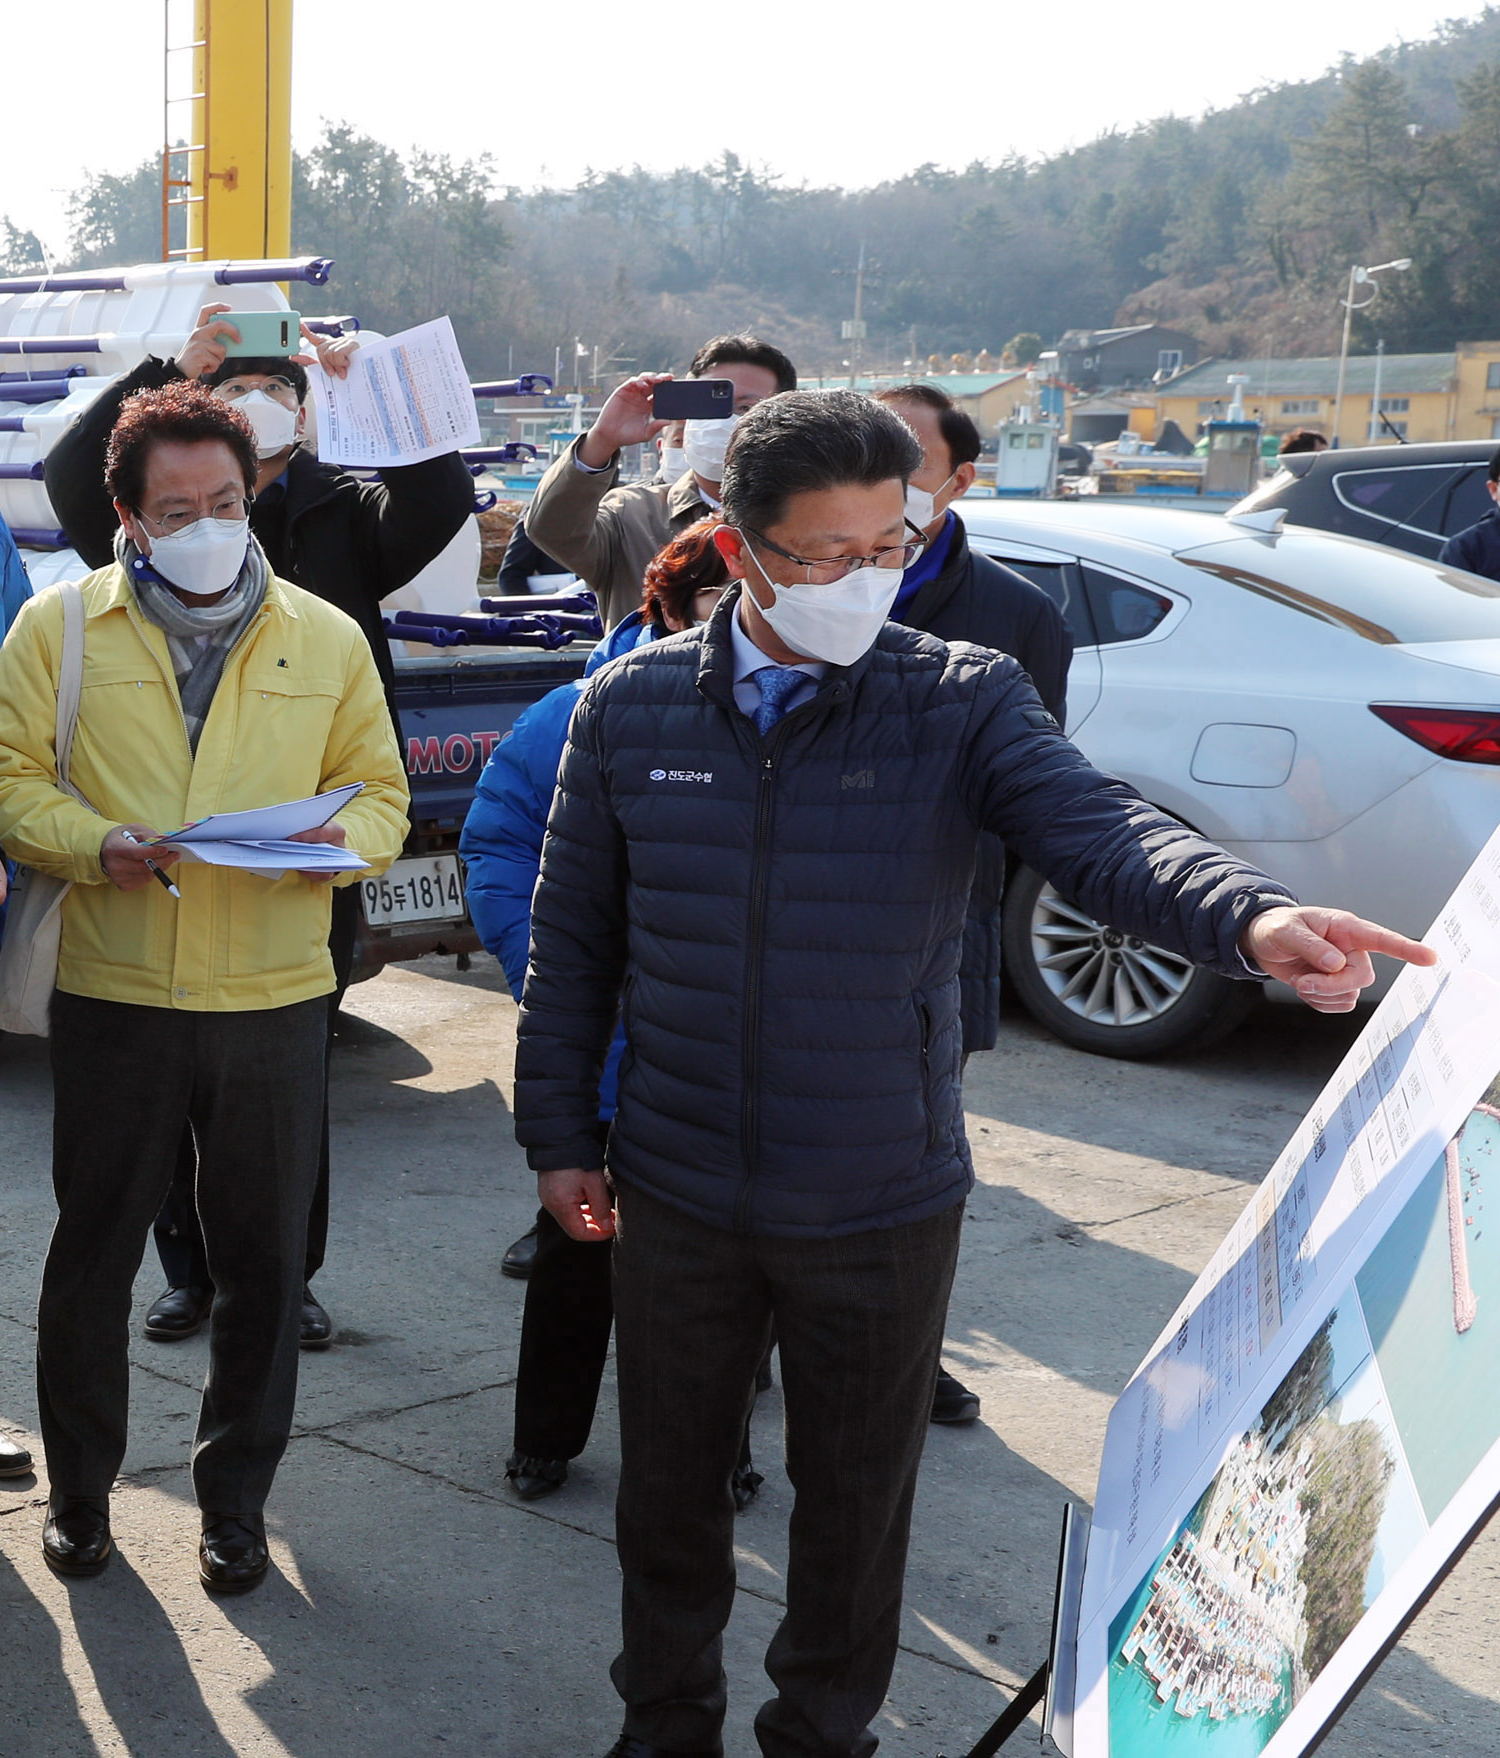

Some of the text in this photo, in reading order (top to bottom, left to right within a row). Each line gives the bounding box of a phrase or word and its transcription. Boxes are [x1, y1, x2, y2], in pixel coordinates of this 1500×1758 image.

[407, 730, 513, 775] MOT
[668, 770, 713, 783] 진도군수협
[365, 872, 460, 914] 95두1814
